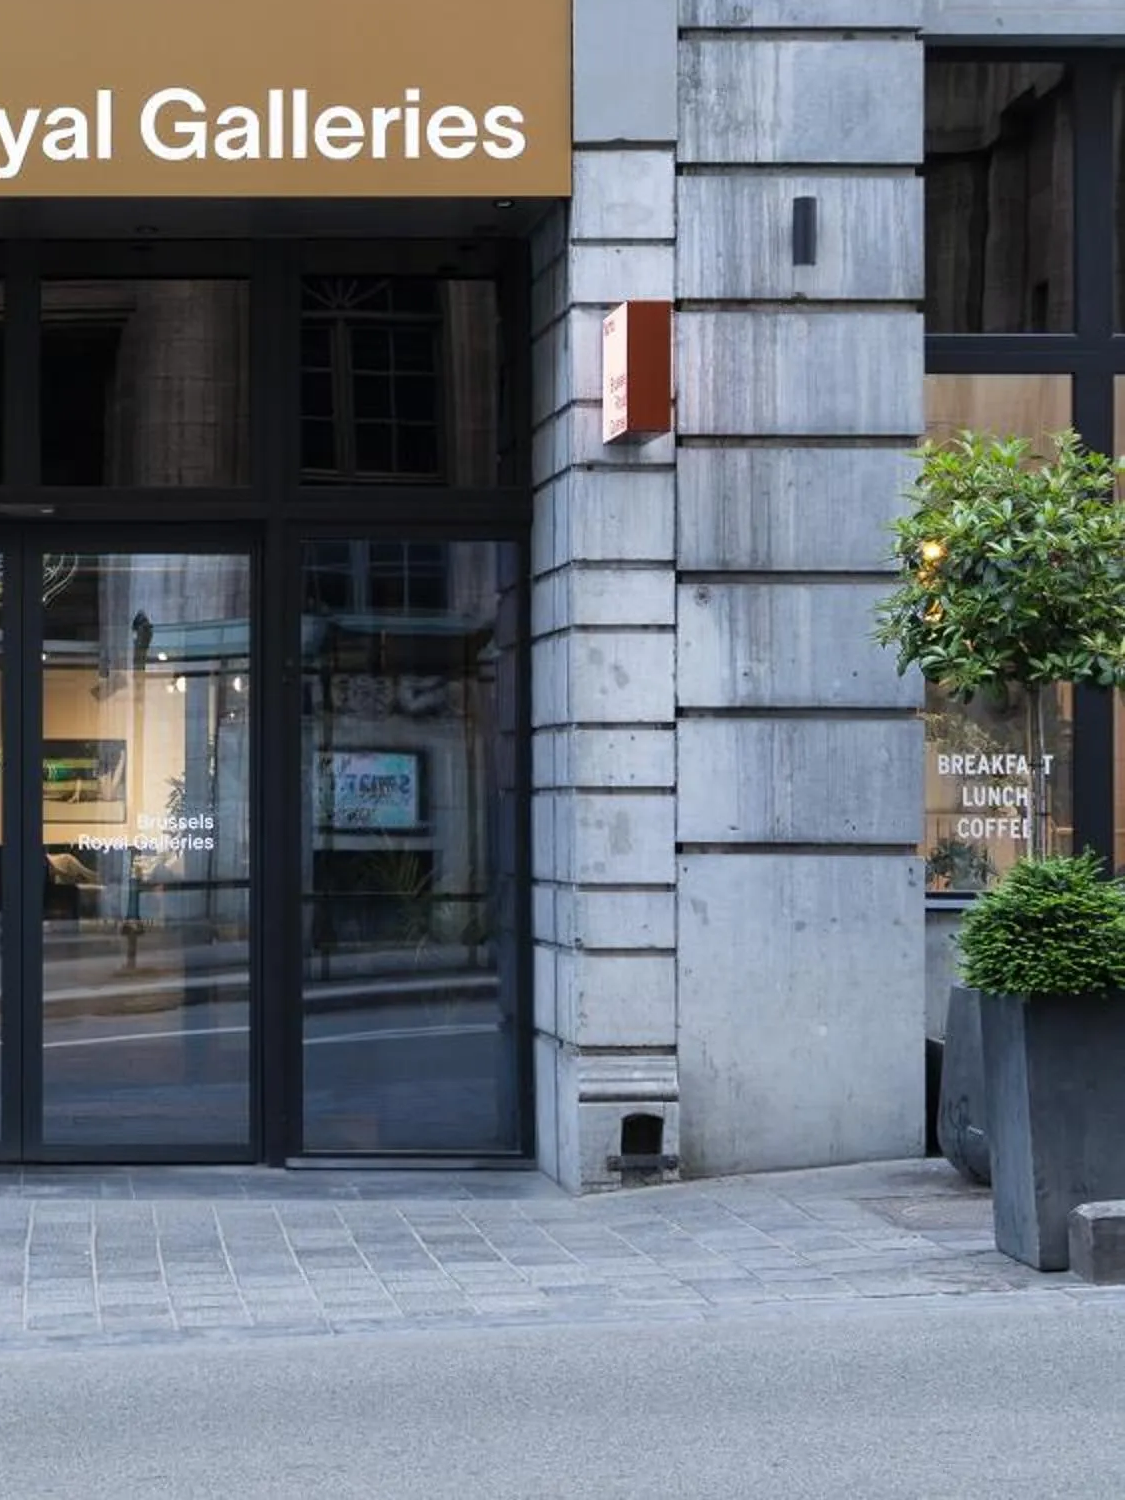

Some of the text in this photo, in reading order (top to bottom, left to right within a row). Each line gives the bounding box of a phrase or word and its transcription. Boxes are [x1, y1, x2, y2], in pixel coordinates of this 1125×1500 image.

[140, 87, 527, 161] Galleries
[938, 754, 1054, 775] BREAKFAT
[962, 786, 1028, 807] LUNCH
[137, 813, 214, 830] Brussels
[78, 833, 214, 854] Royal Galleries
